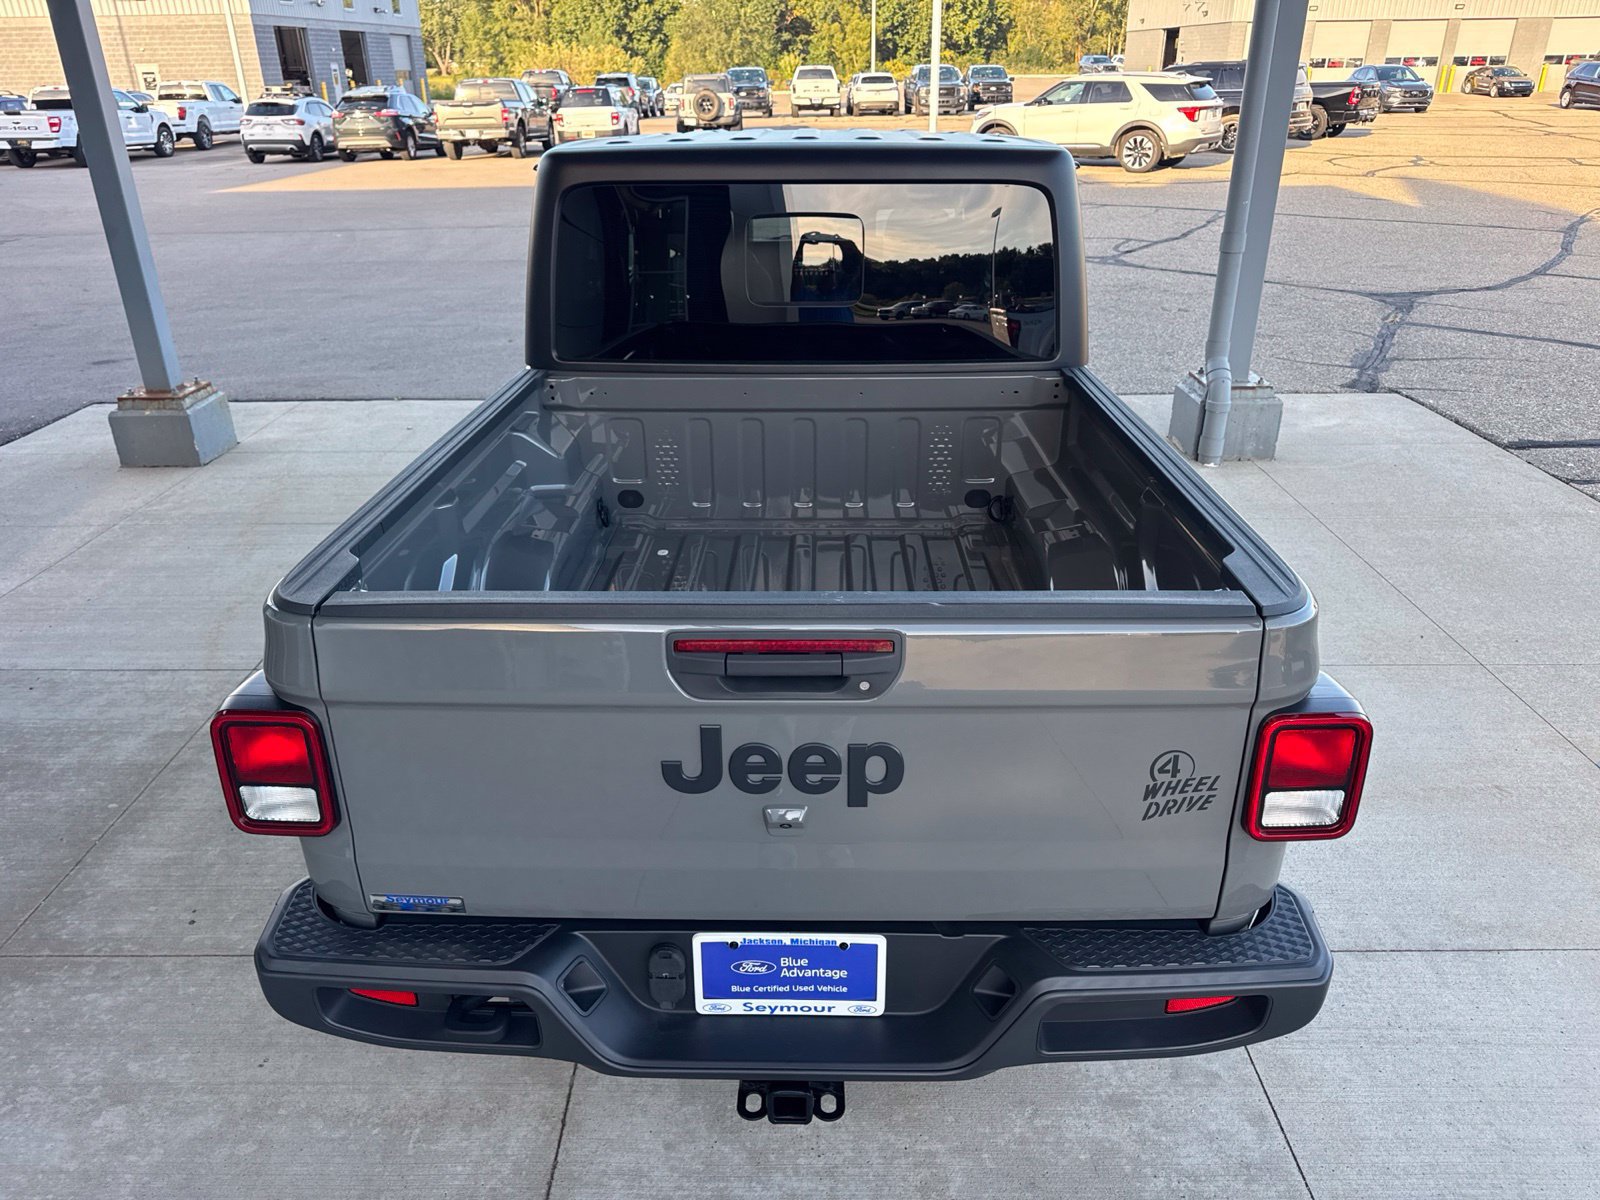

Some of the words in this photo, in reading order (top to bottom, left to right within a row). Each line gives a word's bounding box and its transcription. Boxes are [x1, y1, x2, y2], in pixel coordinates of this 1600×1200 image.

[661, 724, 905, 807] Jeep
[1157, 754, 1181, 778] 4
[1142, 775, 1221, 801] WHEEL
[1141, 794, 1217, 821] DRIVE
[385, 895, 450, 906] Seymour
[790, 938, 838, 946] Michigan
[738, 961, 769, 973] Ford
[780, 957, 809, 967] Blue
[780, 967, 849, 980] Advantage
[731, 985, 751, 993] Blue
[753, 985, 790, 993] Certified
[792, 985, 815, 993] Used
[817, 985, 848, 993] Vehicle
[707, 1004, 729, 1013] Ford
[742, 1002, 836, 1015] Seymour
[852, 1006, 873, 1014] Ford
